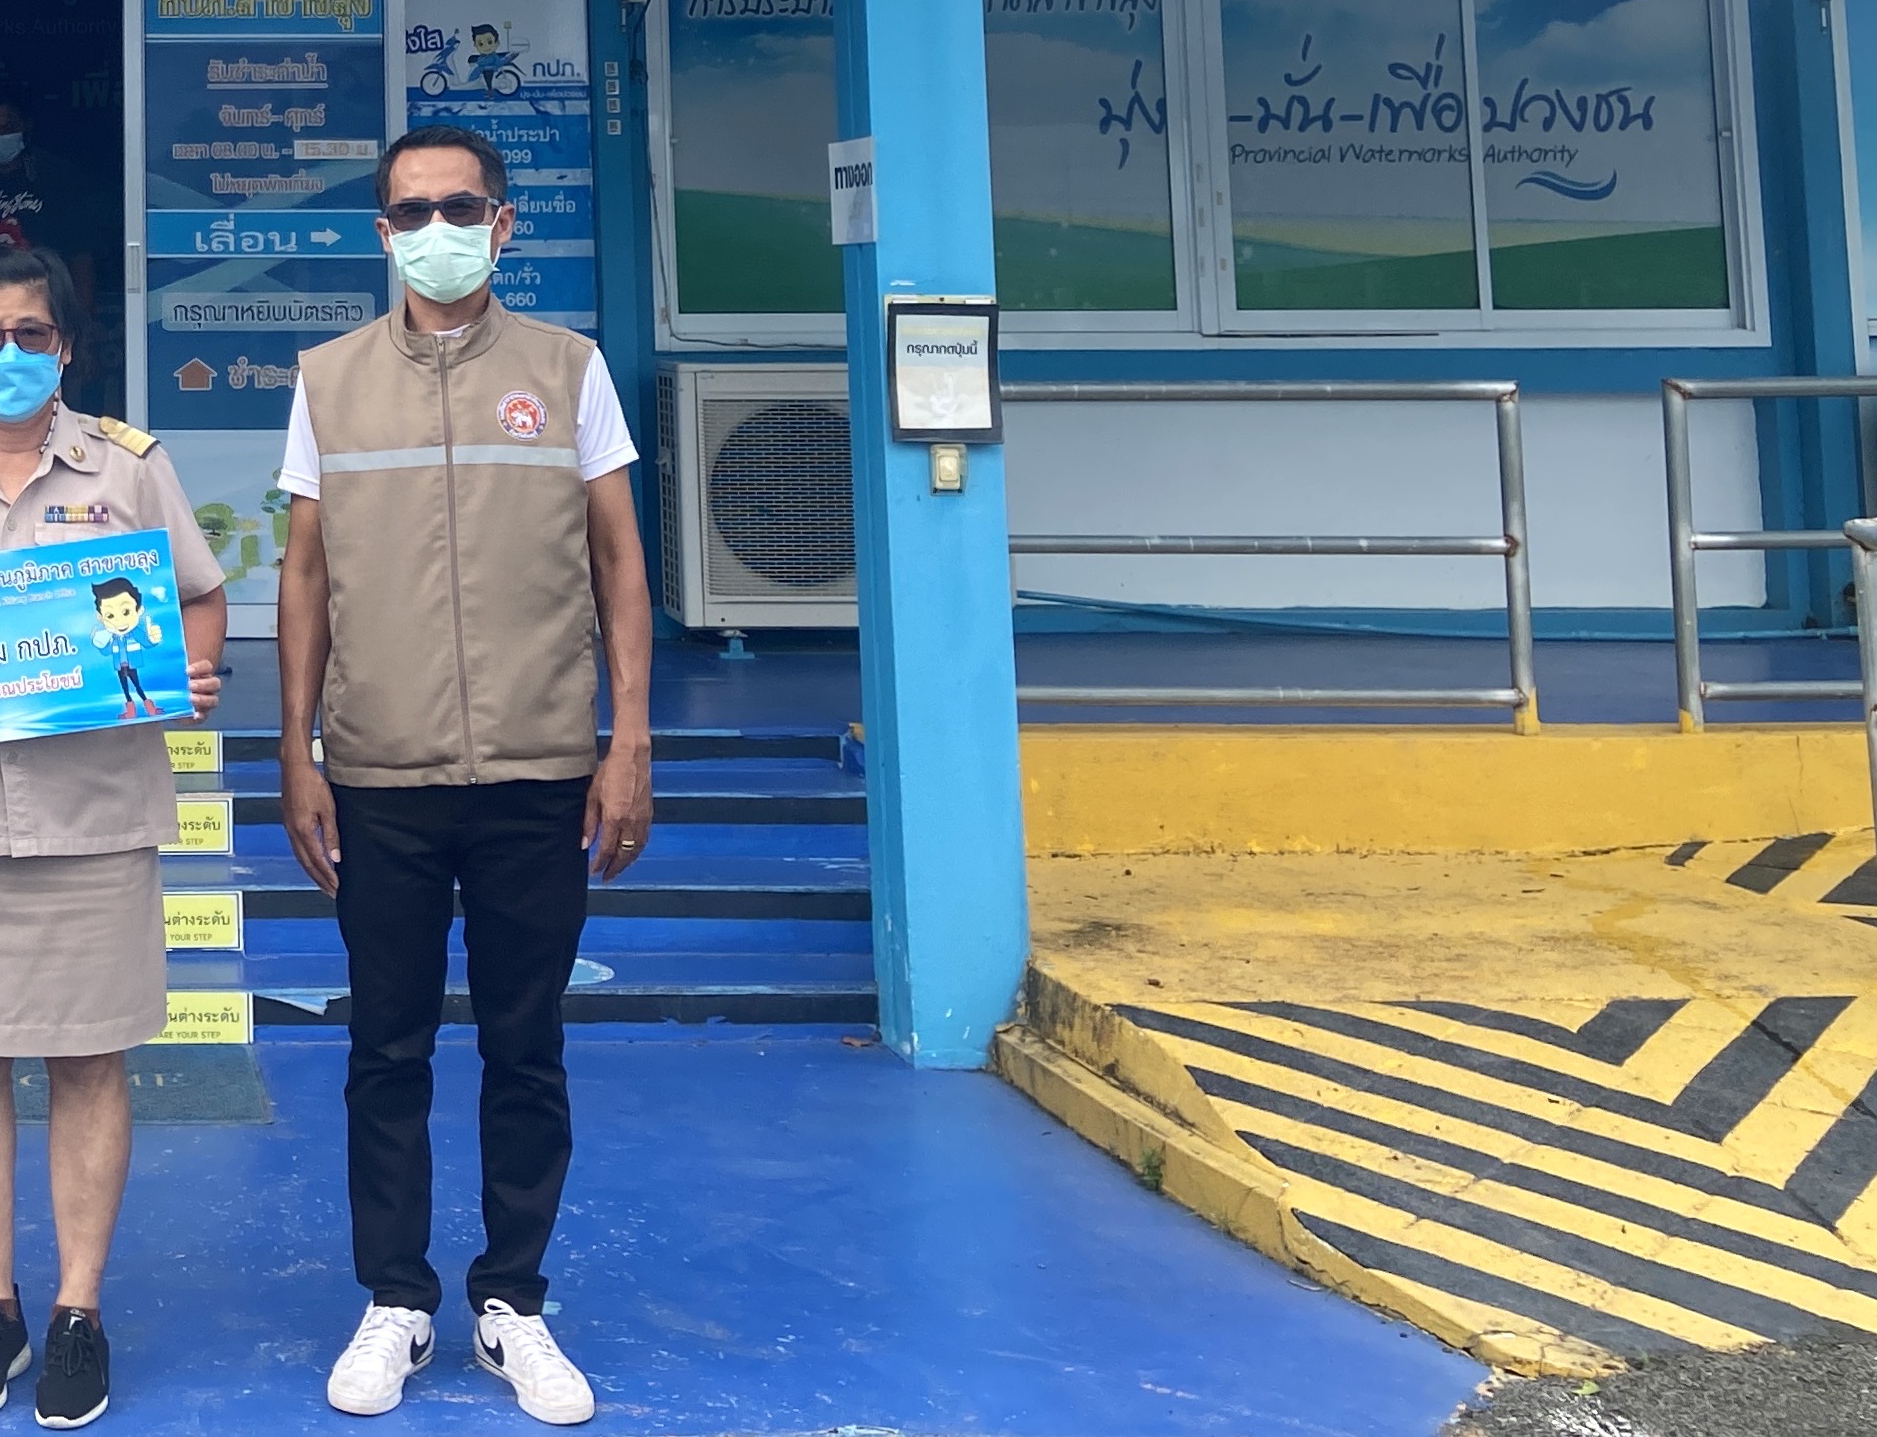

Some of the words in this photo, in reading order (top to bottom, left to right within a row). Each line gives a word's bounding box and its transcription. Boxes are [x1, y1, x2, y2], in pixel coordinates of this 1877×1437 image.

[532, 59, 581, 78] กปภ.
[1229, 142, 1333, 164] Provincial
[1483, 142, 1579, 168] Authority
[195, 213, 298, 252] เลื่อน
[173, 299, 364, 329] กรุณาหยิบบัตรคิว
[79, 548, 160, 580] สาขาขลุง
[17, 630, 79, 661] กปภ.
[193, 933, 213, 941] STEP
[176, 1031, 199, 1039] YOUR
[201, 1031, 221, 1039] STEP
